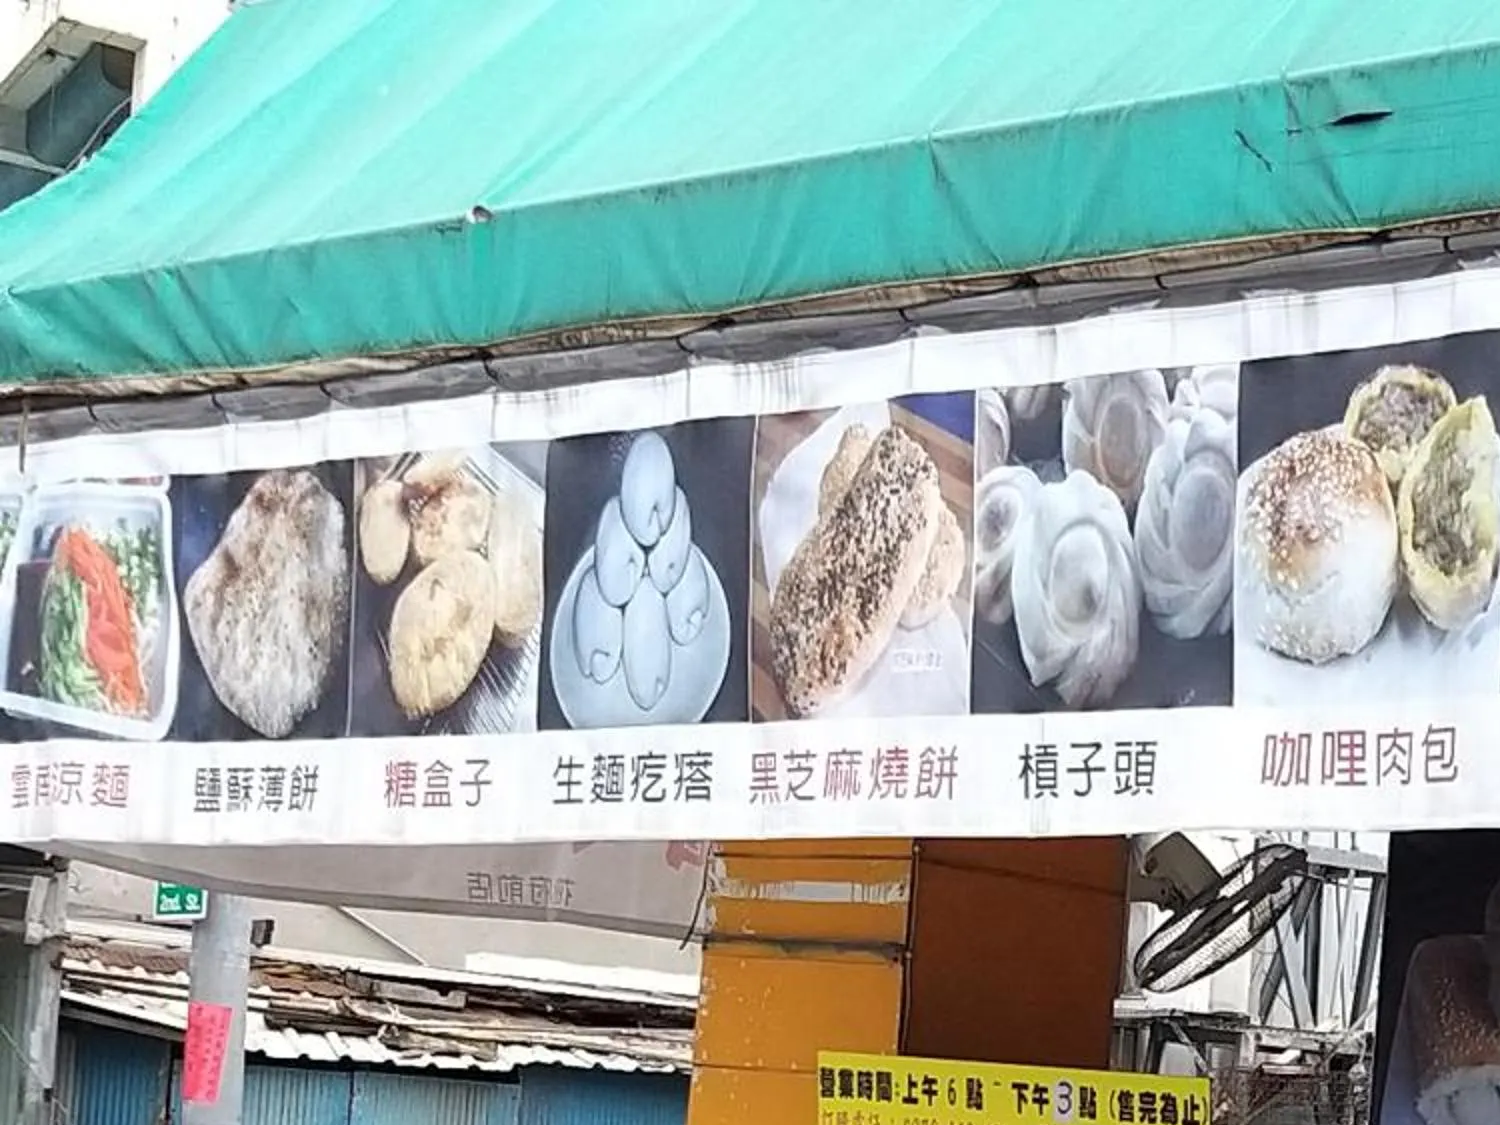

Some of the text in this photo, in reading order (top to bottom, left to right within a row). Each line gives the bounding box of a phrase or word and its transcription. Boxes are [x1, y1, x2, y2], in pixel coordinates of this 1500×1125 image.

[384, 758, 494, 809] 糖盒子
[552, 750, 714, 805] 生麵疙瘩
[748, 744, 959, 805] 黑芝麻燒餅
[1018, 740, 1159, 800] 槓子頭
[1260, 723, 1460, 788] 咖哩肉包
